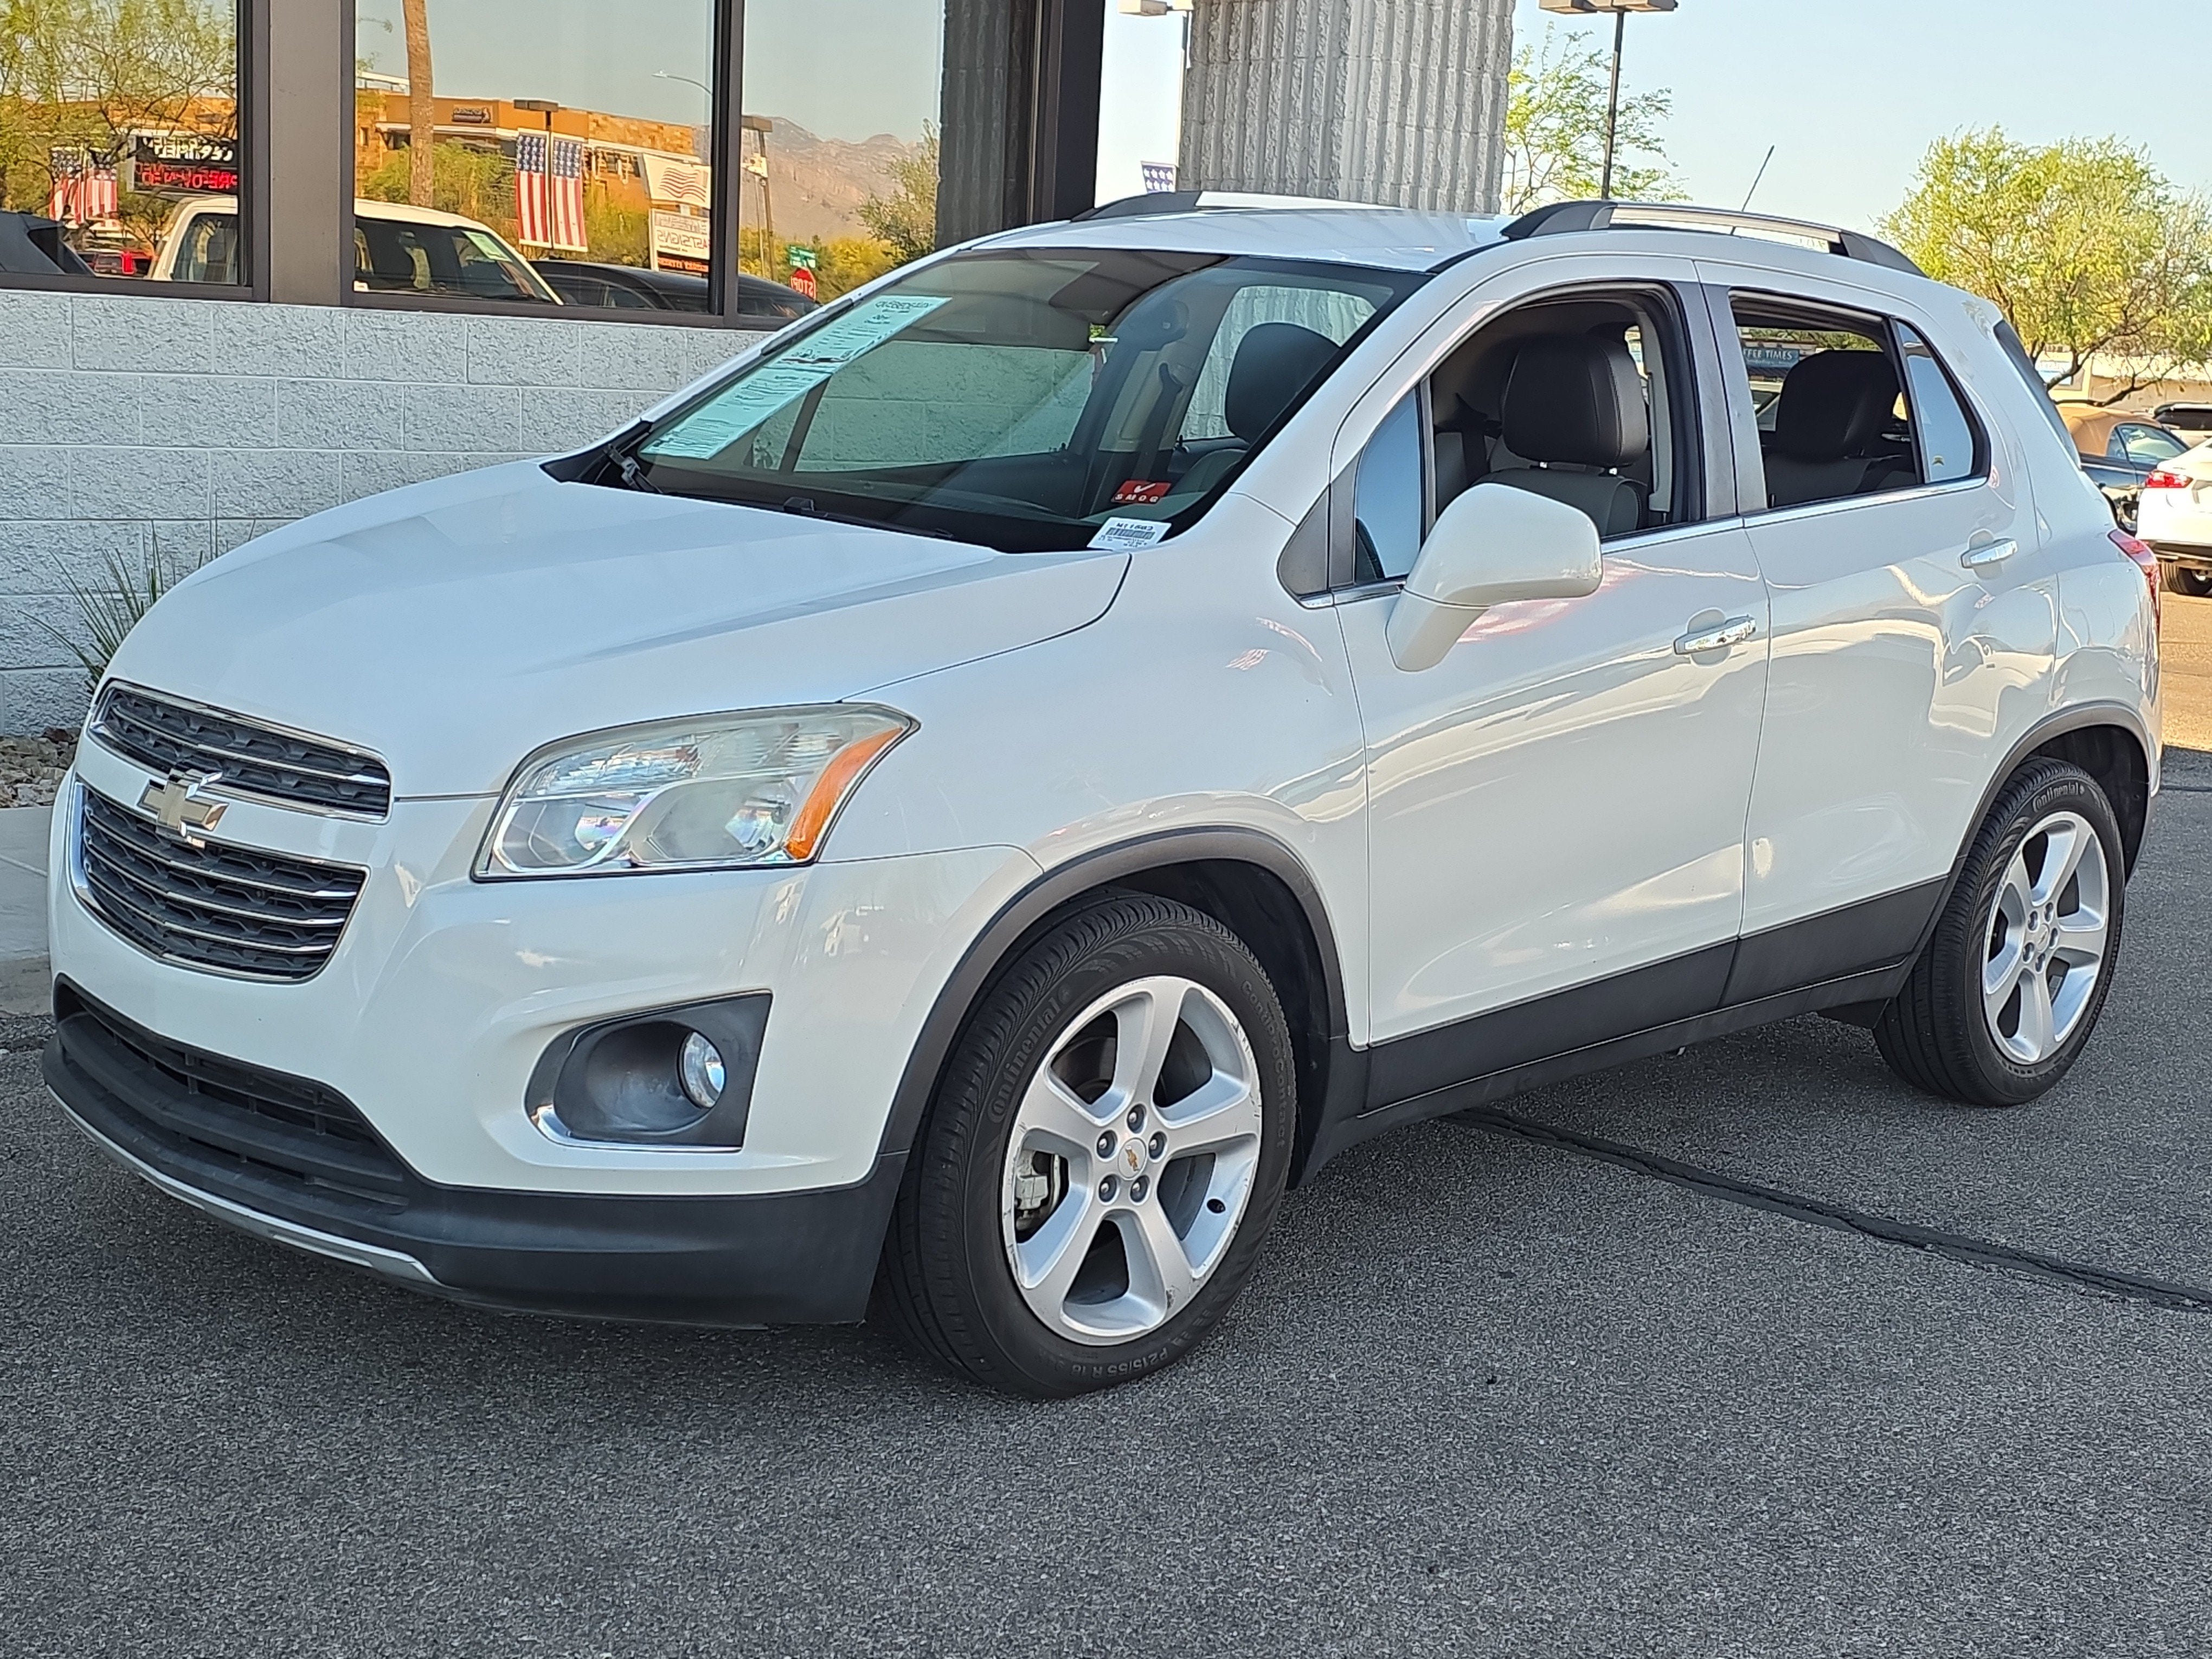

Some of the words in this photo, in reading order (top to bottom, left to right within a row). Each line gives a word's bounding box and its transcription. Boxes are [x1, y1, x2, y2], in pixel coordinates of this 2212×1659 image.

[1743, 348, 1762, 358] FFEE
[1765, 349, 1792, 361] TIMES
[1115, 493, 1159, 503] SMOG
[2033, 781, 2079, 813] Continental
[987, 997, 1060, 1123] Continental
